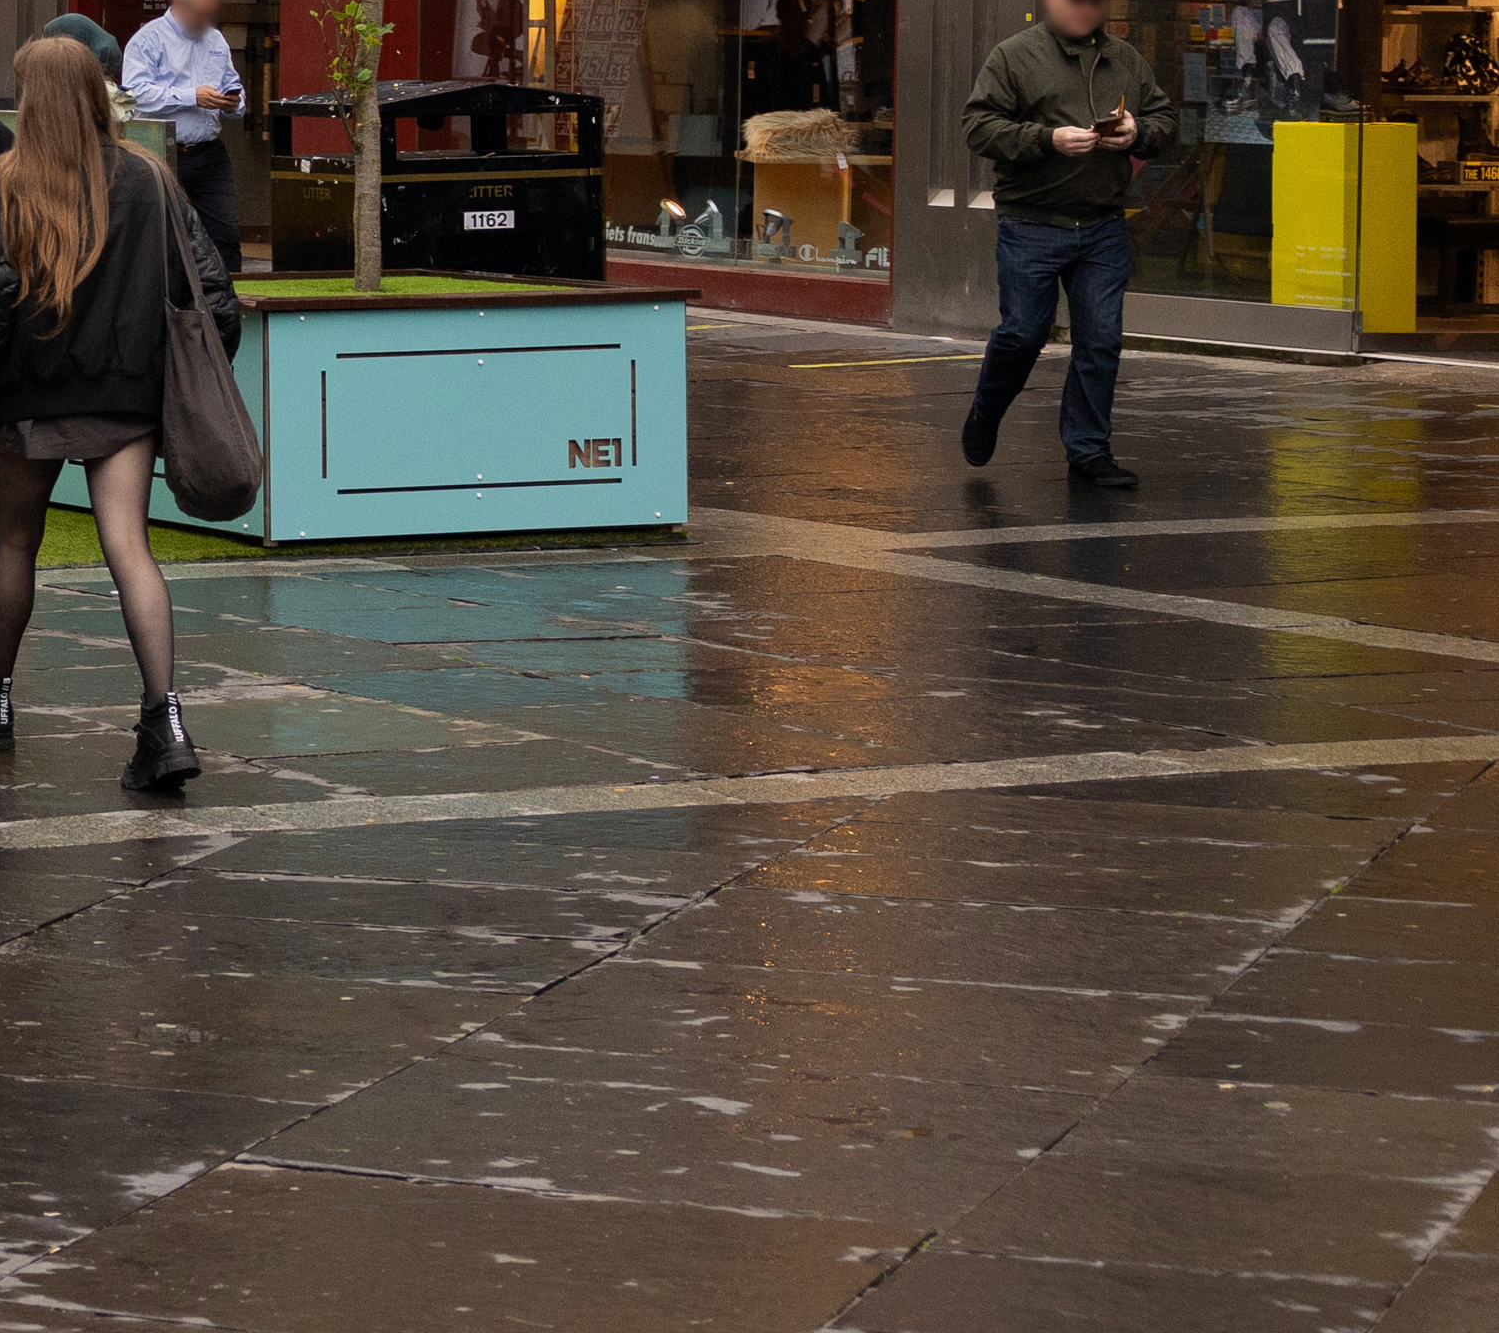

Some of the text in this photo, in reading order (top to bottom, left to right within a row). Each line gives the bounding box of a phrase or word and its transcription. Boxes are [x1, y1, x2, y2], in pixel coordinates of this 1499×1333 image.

[1464, 169, 1479, 180] THE
[303, 187, 331, 201] LITTER
[470, 212, 508, 228] 1162
[676, 235, 708, 246] Dickies
[799, 243, 858, 272] Champion
[568, 437, 622, 469] NE1
[0, 692, 10, 725] UFFALO
[167, 704, 184, 743] UFFALO
